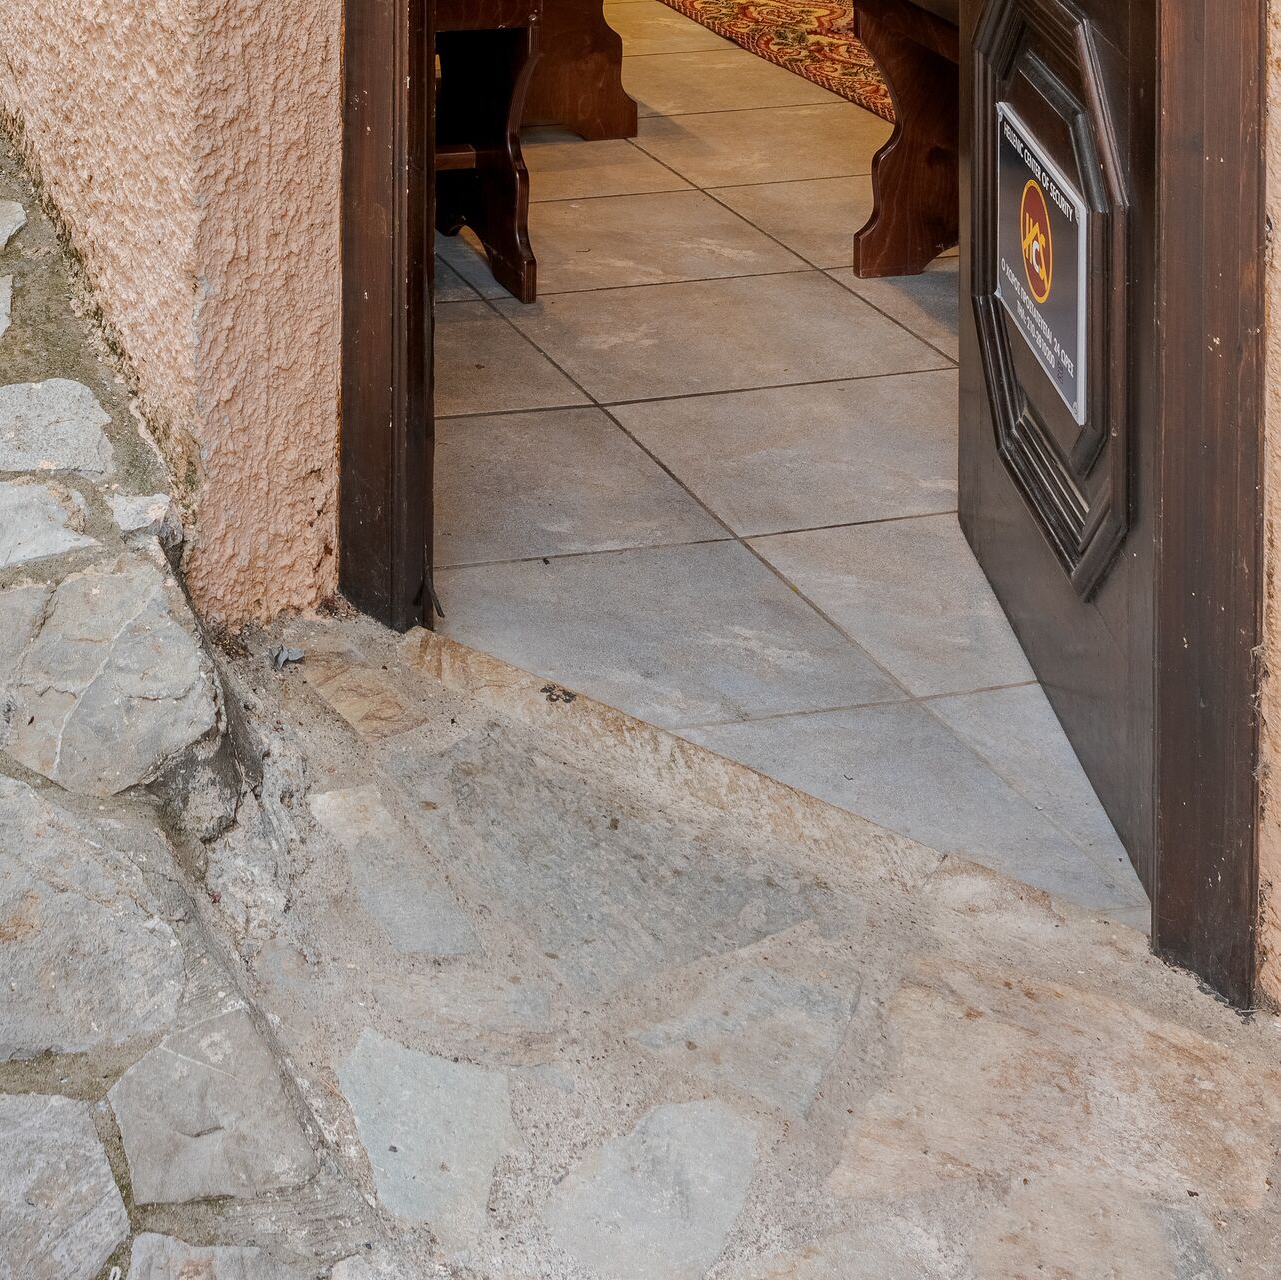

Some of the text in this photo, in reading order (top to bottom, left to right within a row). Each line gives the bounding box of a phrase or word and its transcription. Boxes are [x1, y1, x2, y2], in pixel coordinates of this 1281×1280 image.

[1003, 121, 1074, 224] HELLENIC CENTER OF SECURITY
[1053, 336, 1061, 359] 24
